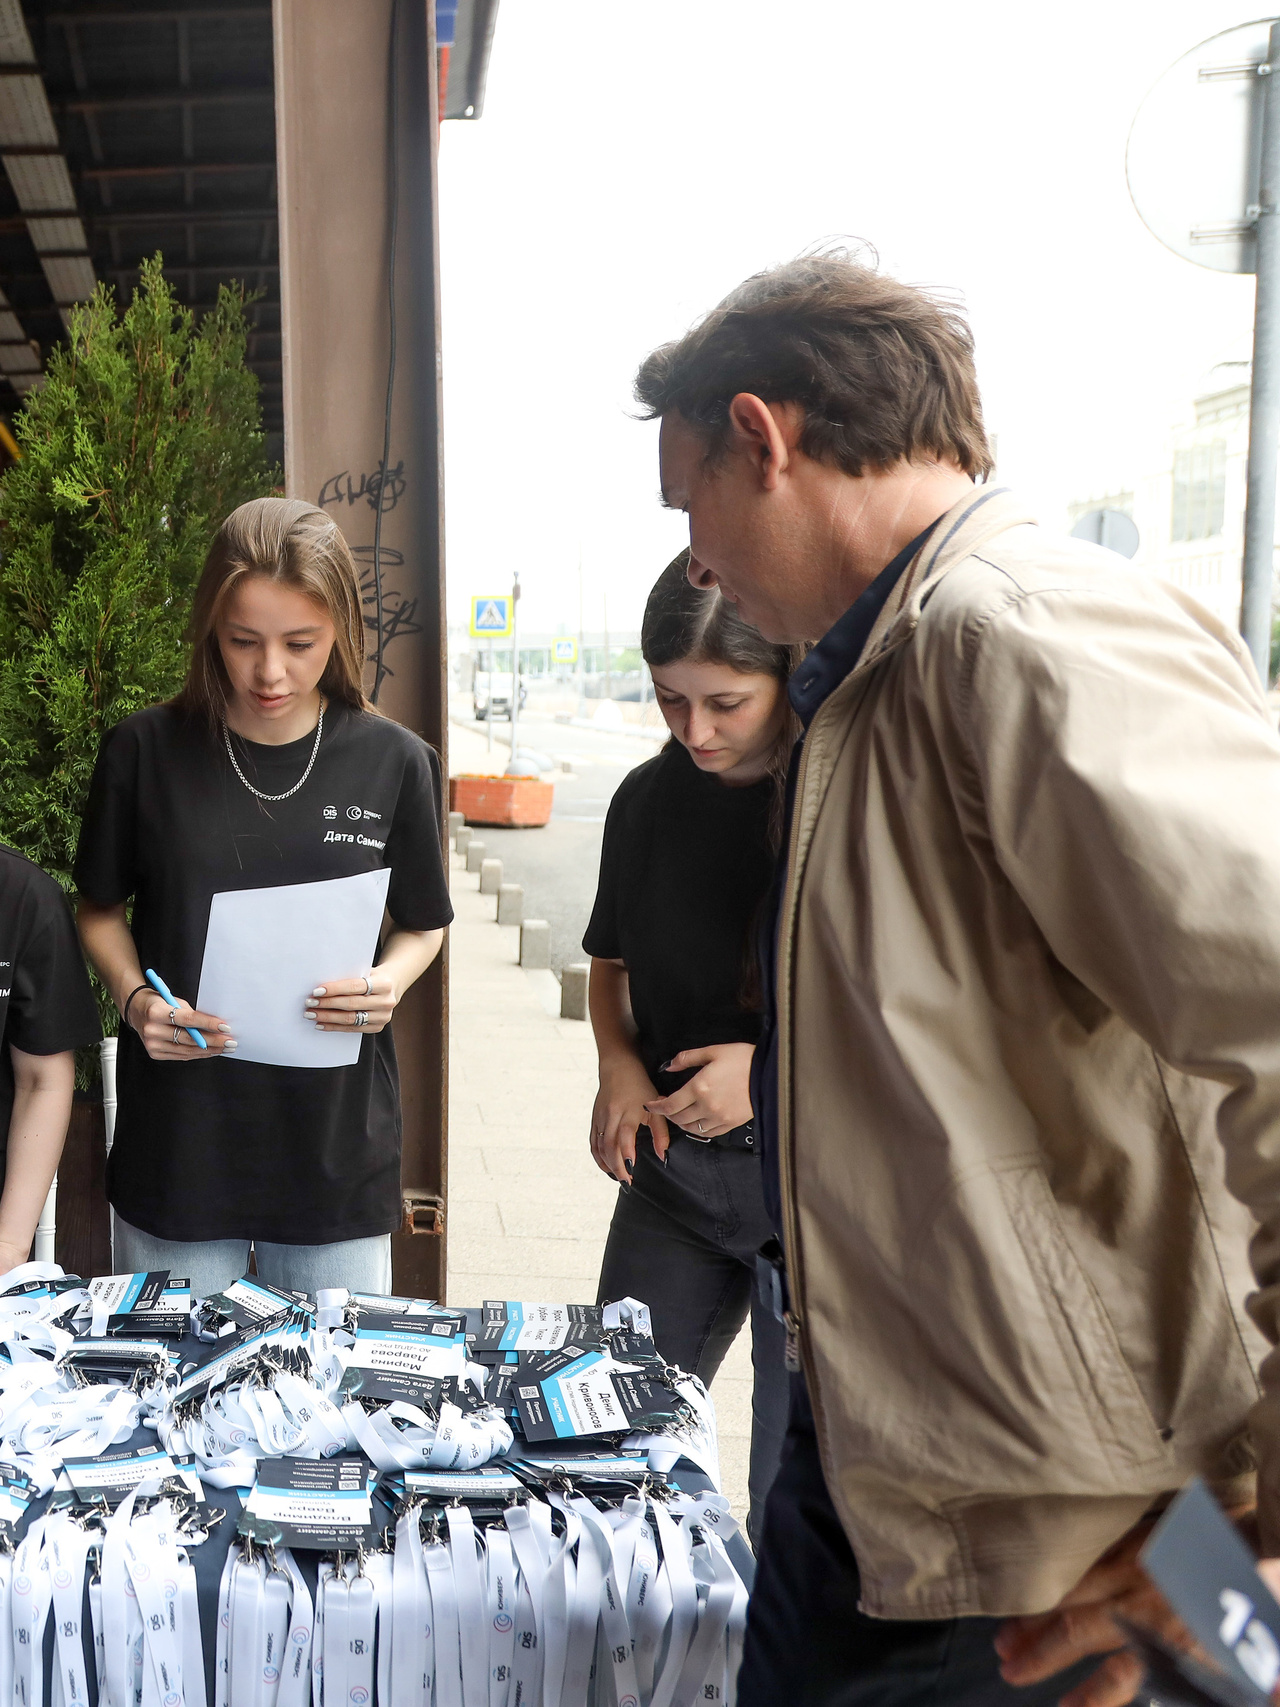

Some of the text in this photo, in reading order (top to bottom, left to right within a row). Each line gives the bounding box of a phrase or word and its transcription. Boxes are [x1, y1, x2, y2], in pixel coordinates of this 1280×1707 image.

[323, 831, 354, 843] Дата
[385, 1334, 426, 1342] УЧАСТНИК
[549, 1325, 564, 1345] Алевтина
[371, 1350, 428, 1362] Лаврова
[371, 1359, 422, 1371] Марина
[377, 1376, 435, 1390] Дата Саммит
[622, 1376, 643, 1409] Дата Саммит
[551, 1396, 565, 1423] УЧАСТНИК
[578, 1382, 602, 1429] Кривоносов
[598, 1392, 616, 1417] Денис
[298, 1408, 311, 1423] DIS
[444, 1428, 452, 1441] DIS
[103, 1474, 145, 1483] Антон
[273, 1512, 352, 1522] Владимир
[289, 1506, 336, 1514] Вавра
[703, 1508, 720, 1524] DIS
[296, 1528, 337, 1536] Саммит
[638, 1573, 648, 1606] ЮНИВЕРС
[64, 1621, 73, 1637] DIS
[151, 1614, 162, 1631] DIS
[19, 1628, 27, 1644] DIS
[522, 1632, 532, 1649] DIS
[266, 1632, 274, 1664] ЮНИВЕРС
[355, 1639, 363, 1655] DIS
[617, 1646, 626, 1664] DIS
[293, 1647, 303, 1679] ЮНИВЕРС
[497, 1665, 506, 1681] DIS
[705, 1684, 714, 1700] DIS
